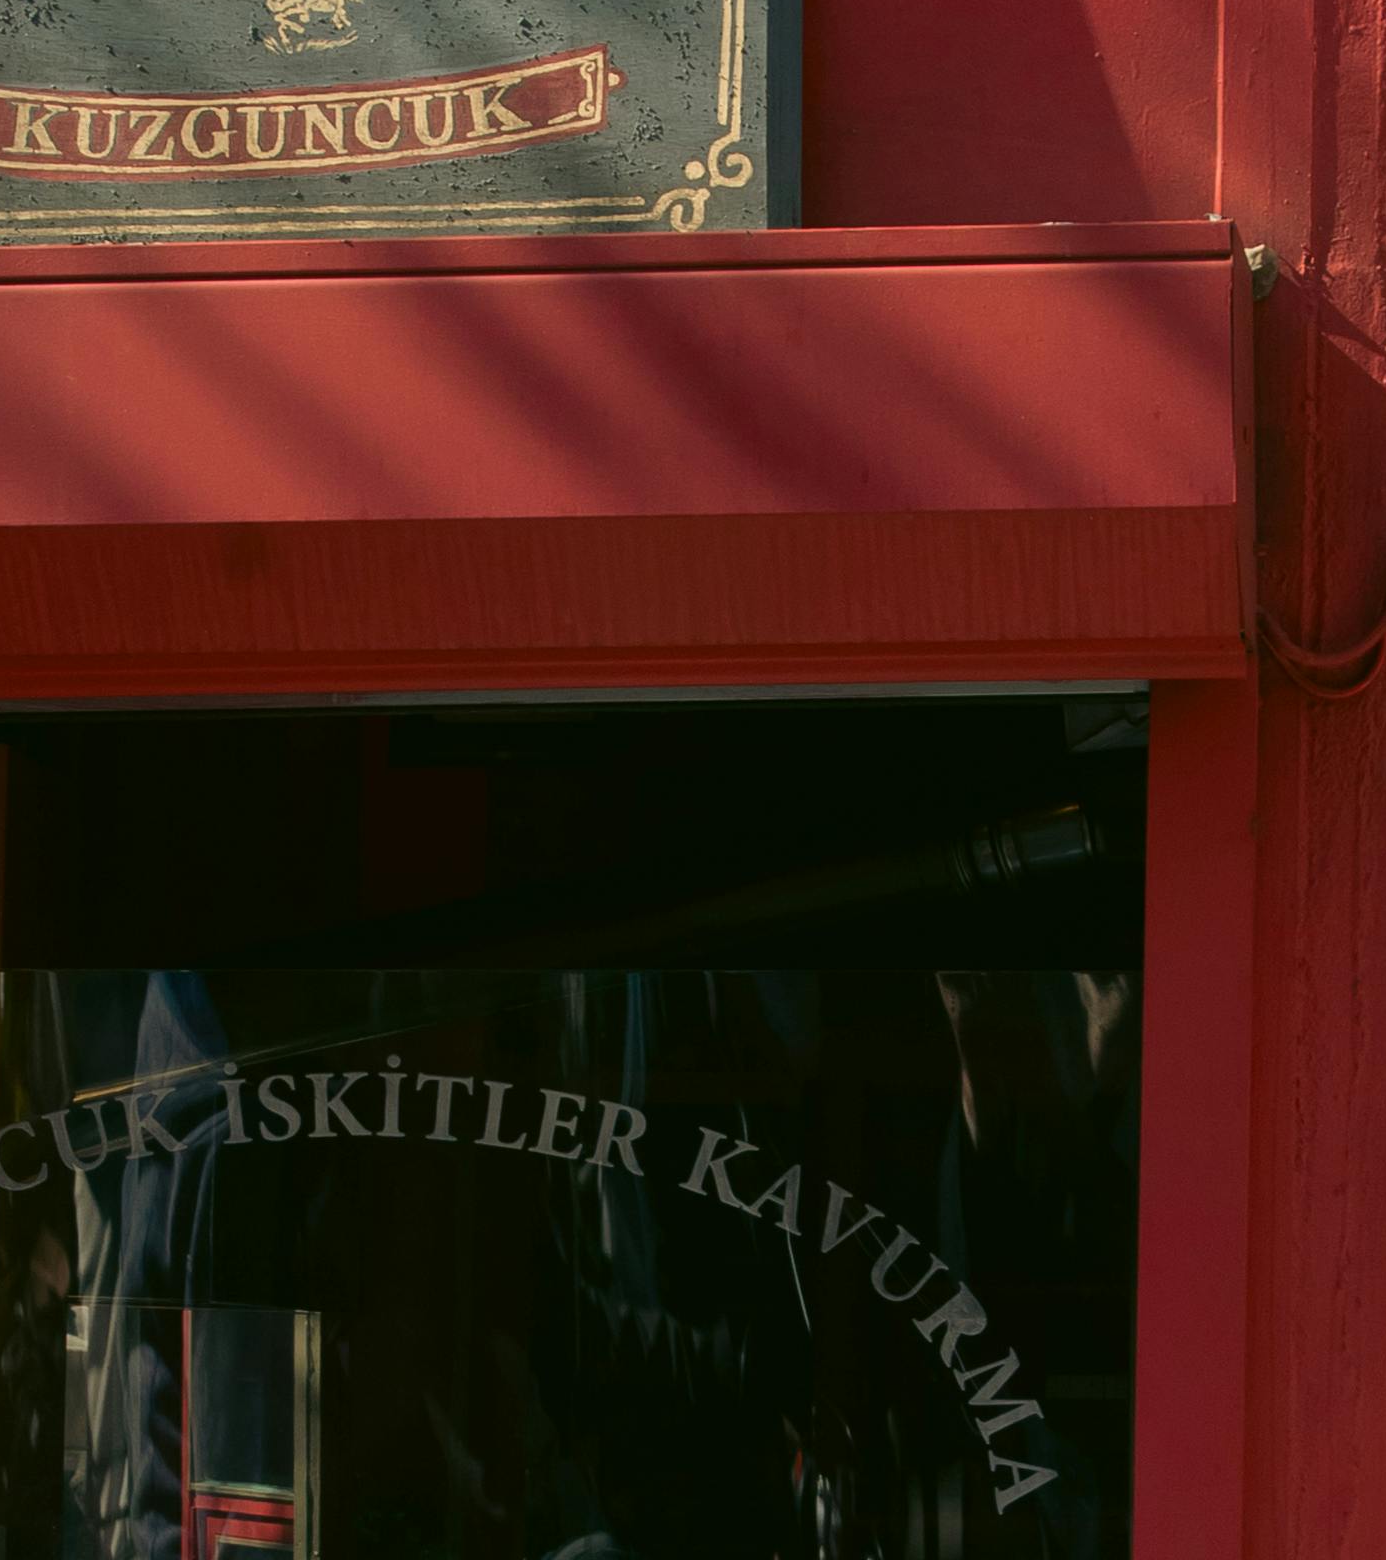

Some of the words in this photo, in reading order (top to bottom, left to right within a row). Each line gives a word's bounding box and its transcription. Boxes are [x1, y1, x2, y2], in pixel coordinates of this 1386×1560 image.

[2, 78, 531, 160] KUZGUNCUK
[217, 1054, 648, 1176] İSKİTLER
[678, 1126, 1059, 1515] KAVURMA
